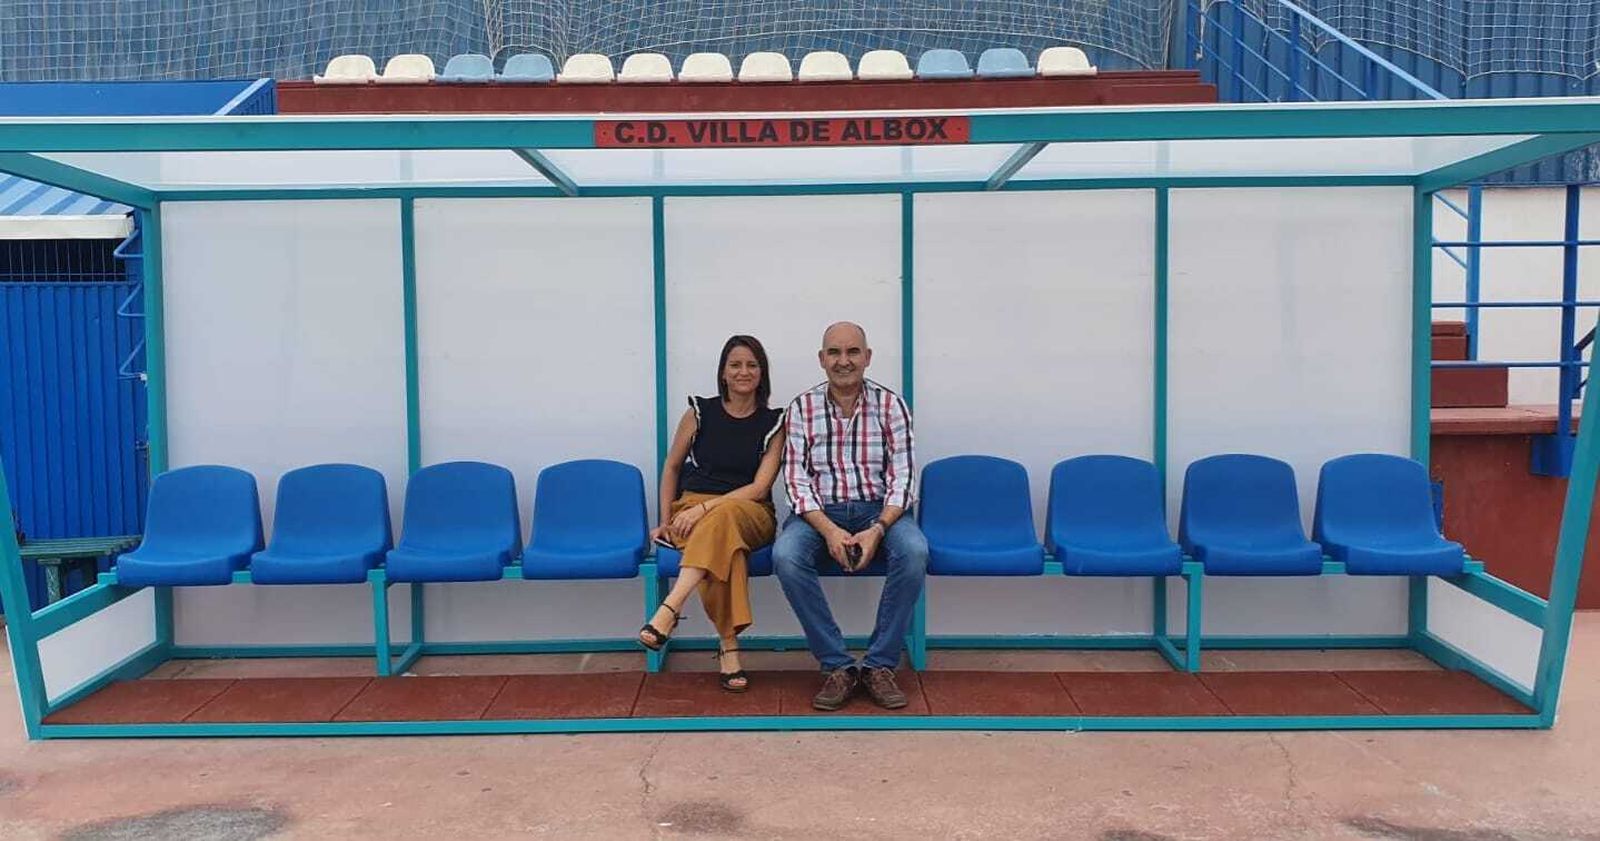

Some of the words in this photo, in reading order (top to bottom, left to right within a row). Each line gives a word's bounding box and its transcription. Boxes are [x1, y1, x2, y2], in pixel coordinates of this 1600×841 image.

[614, 122, 676, 143] C.D.
[686, 121, 779, 143] VILLA
[789, 120, 830, 142] DE
[840, 118, 948, 141] ALBOX
